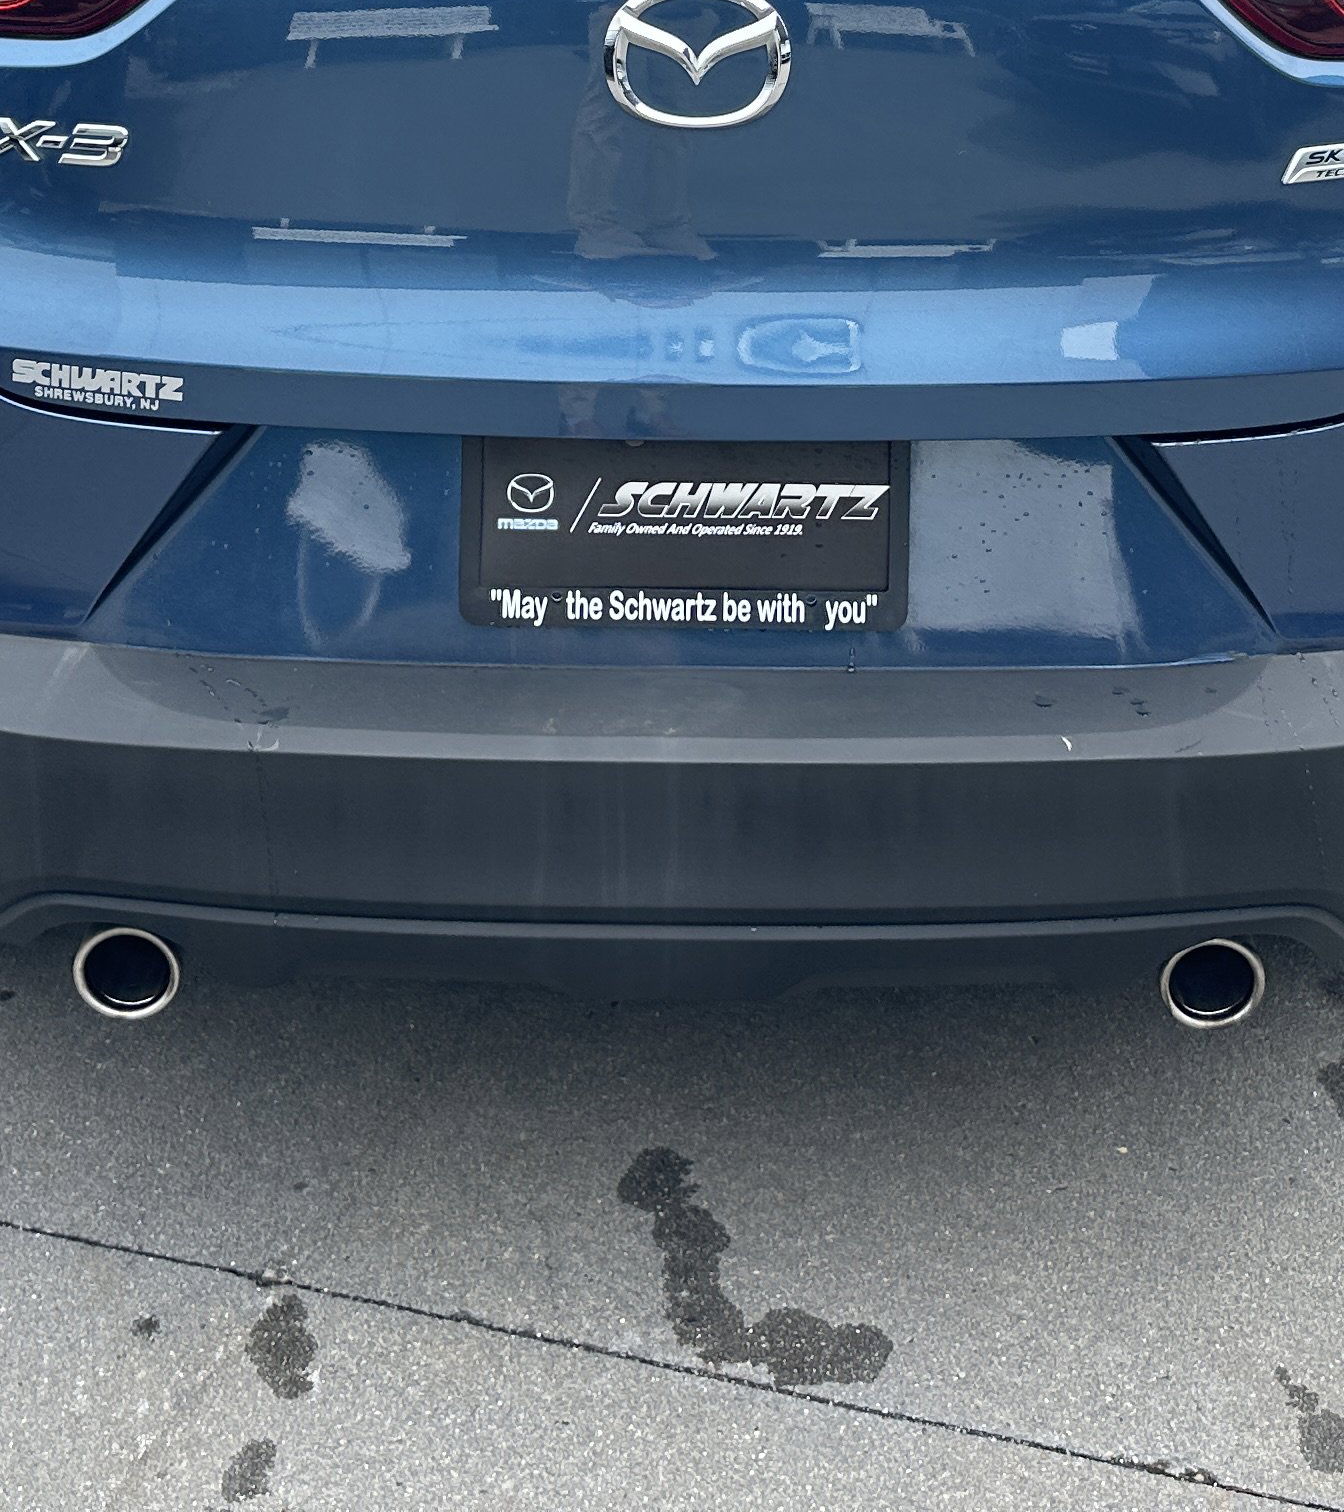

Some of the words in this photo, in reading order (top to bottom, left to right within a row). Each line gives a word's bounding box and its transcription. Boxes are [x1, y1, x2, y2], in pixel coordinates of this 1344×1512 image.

[12, 358, 184, 402] SCHWARTZ
[34, 385, 136, 410] SHREWSBURY,
[140, 398, 160, 411] NJ
[597, 481, 891, 520] SCHWARTZ
[588, 521, 623, 536] Family
[625, 523, 665, 535] Owned
[666, 522, 689, 535] And
[691, 523, 742, 538] Operated
[742, 523, 774, 536] Since
[490, 588, 549, 628] "May
[565, 589, 603, 621] the
[608, 589, 717, 624] Schwartz
[722, 591, 752, 623] be
[756, 592, 805, 624] with
[824, 593, 878, 632] you"
